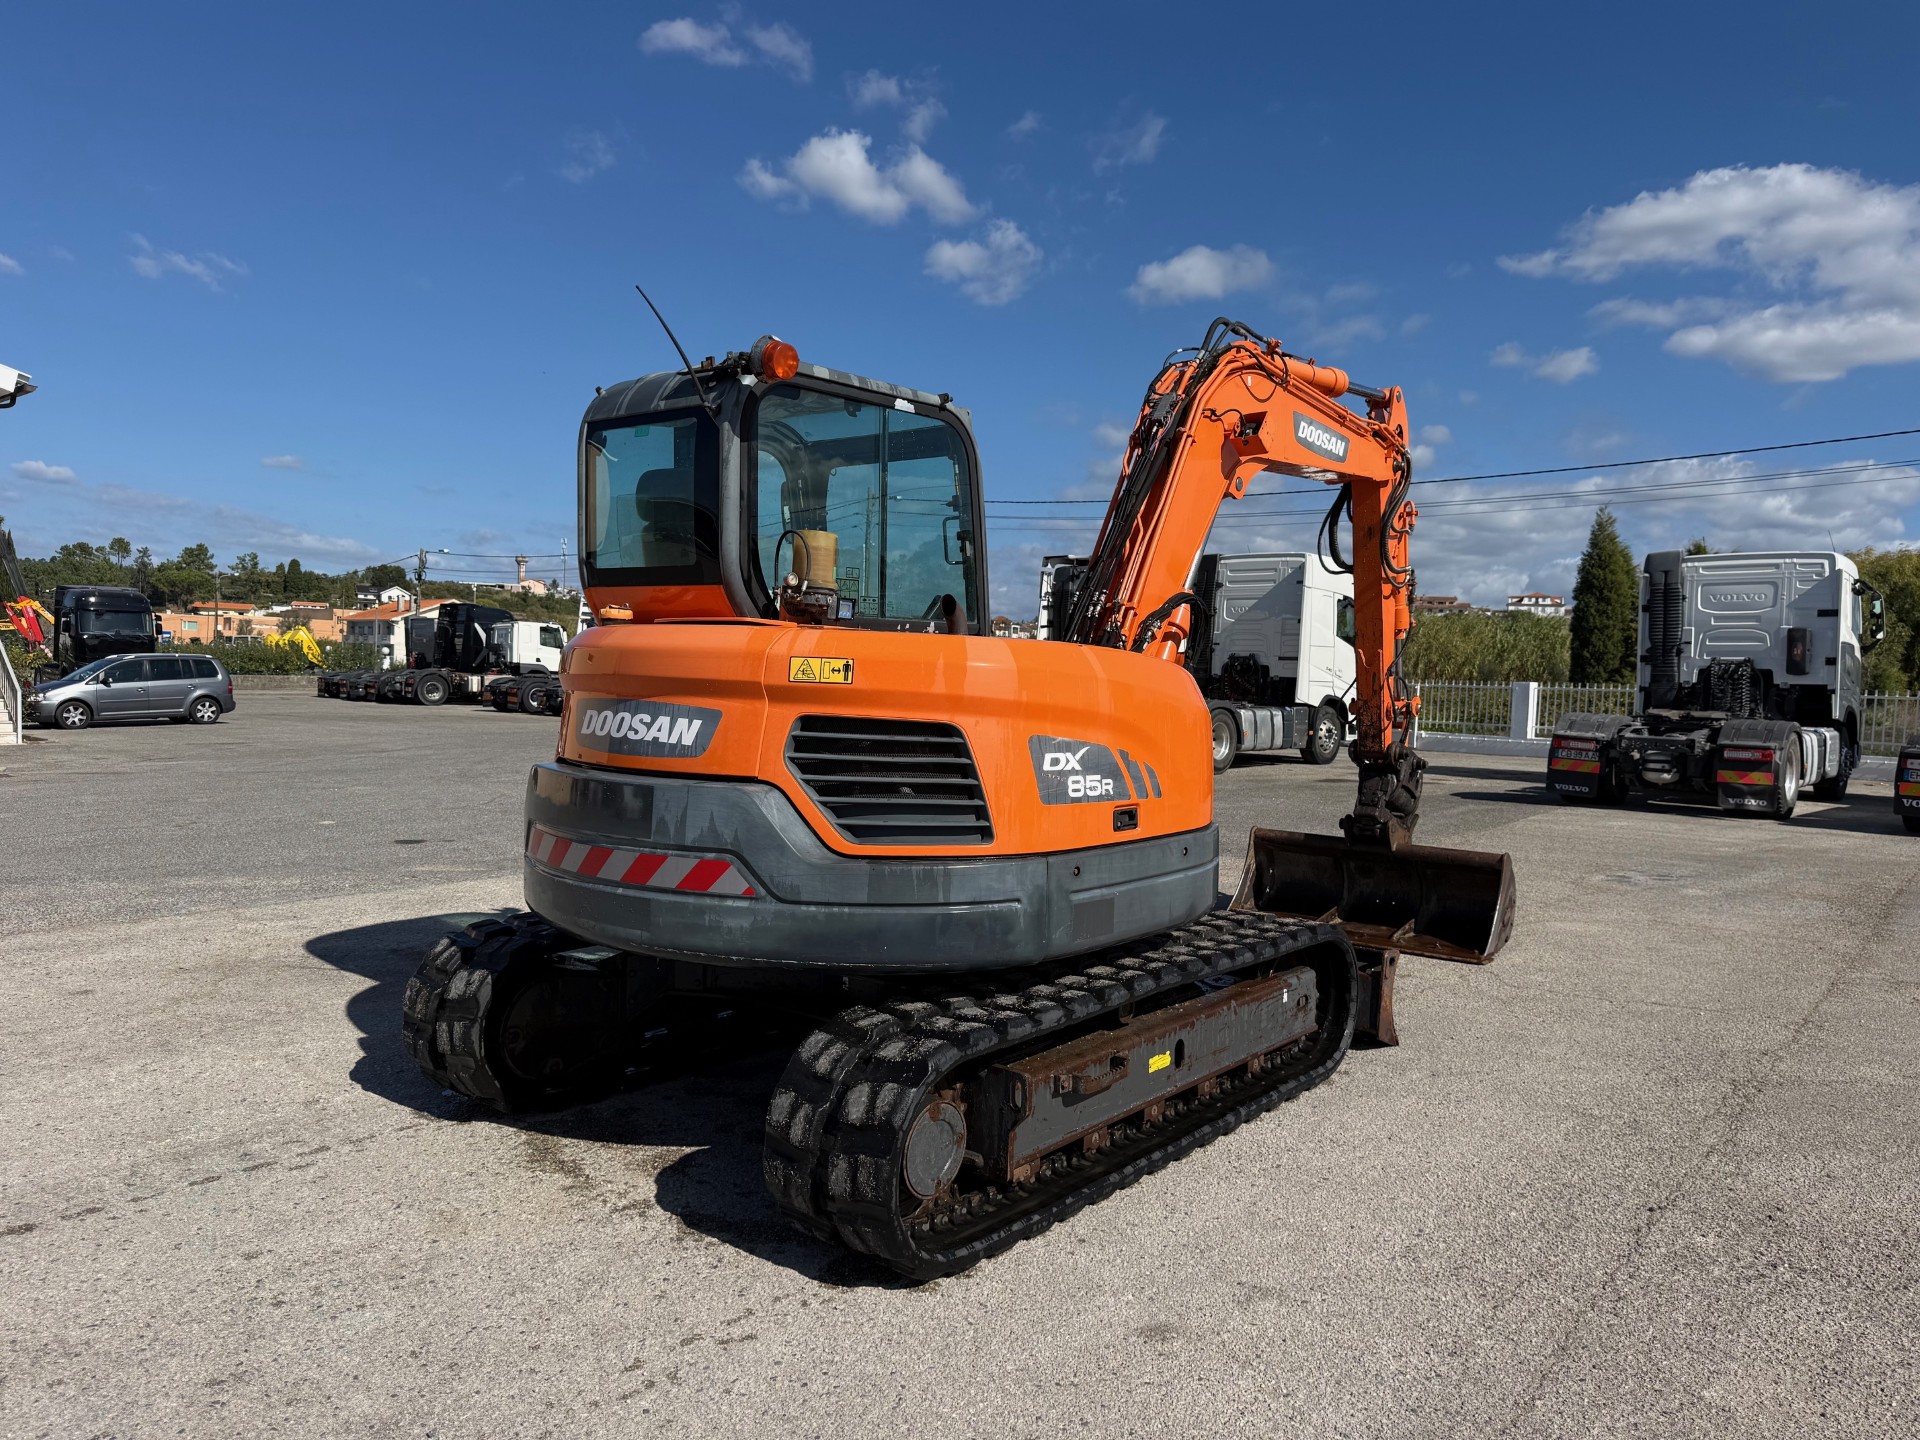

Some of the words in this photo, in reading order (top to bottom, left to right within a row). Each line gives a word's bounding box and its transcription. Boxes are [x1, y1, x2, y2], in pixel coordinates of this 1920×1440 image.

[1298, 421, 1346, 457] DOOSAN
[1709, 593, 1767, 603] VOLVO
[581, 709, 703, 746] DOOSAN
[1042, 746, 1091, 771] DX
[1554, 783, 1589, 793] VOLVO
[1727, 797, 1768, 807] VOLVO
